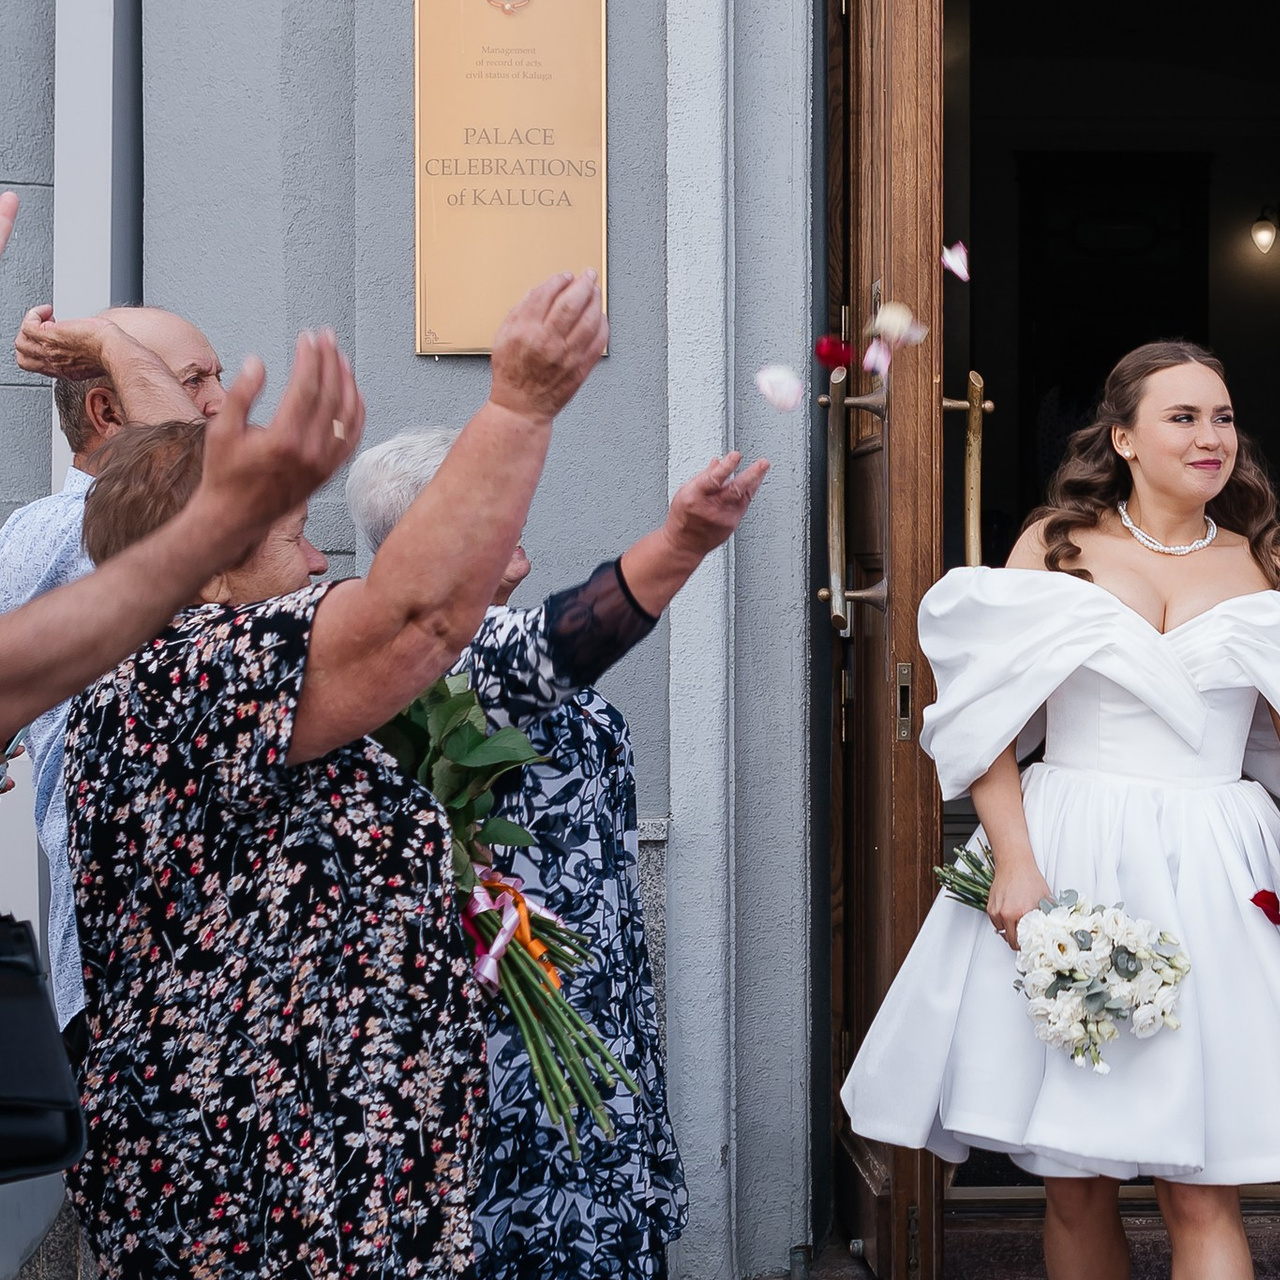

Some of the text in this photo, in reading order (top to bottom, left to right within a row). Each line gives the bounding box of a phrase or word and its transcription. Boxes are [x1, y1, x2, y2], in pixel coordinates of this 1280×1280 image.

[481, 46, 536, 56] Management
[475, 59, 542, 67] of record of acts
[465, 71, 553, 81] civil status of Kaluga
[464, 127, 555, 146] PALACE
[425, 158, 597, 177] CELEBRATIONS
[446, 188, 573, 207] of KALUGA
